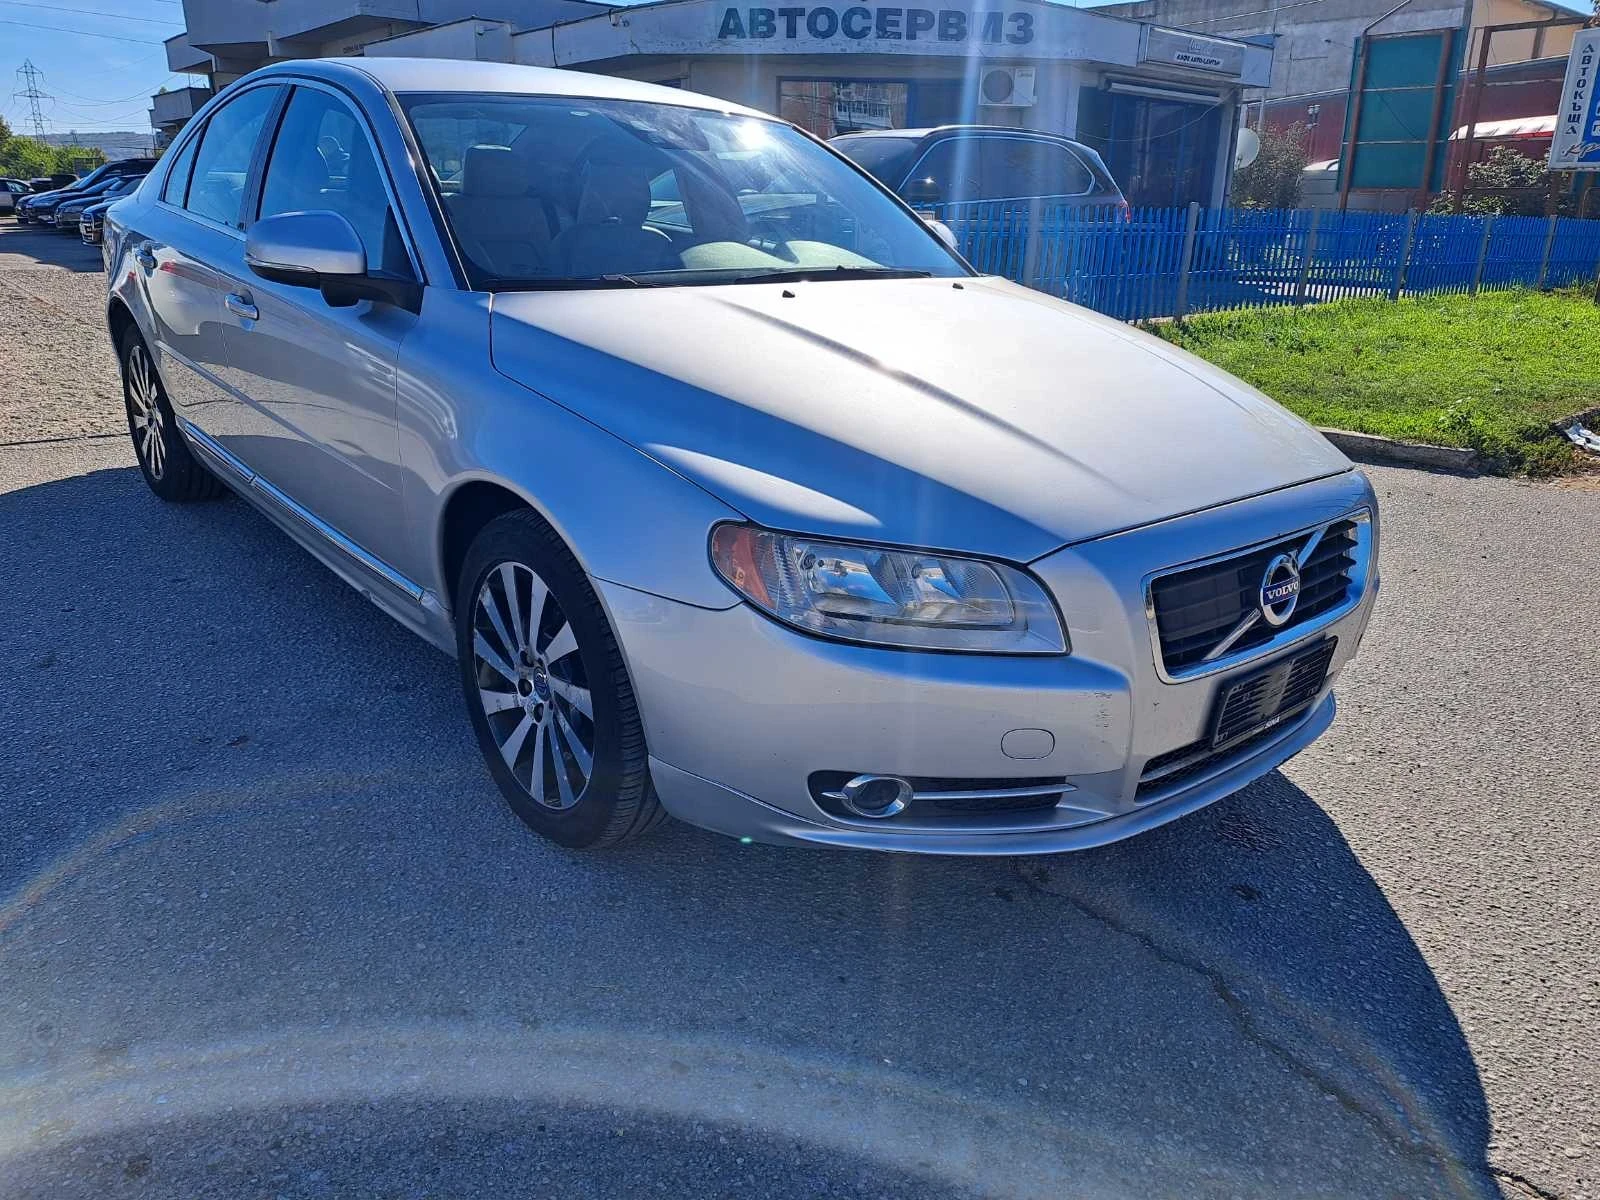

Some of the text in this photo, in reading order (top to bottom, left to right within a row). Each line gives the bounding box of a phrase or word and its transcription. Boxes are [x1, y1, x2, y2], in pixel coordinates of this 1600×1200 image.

[717, 7, 1034, 45] АВТОСЕРВИЗ
[1565, 43, 1595, 135] АВТОКЪЩА
[1266, 581, 1299, 600] VOLVO
